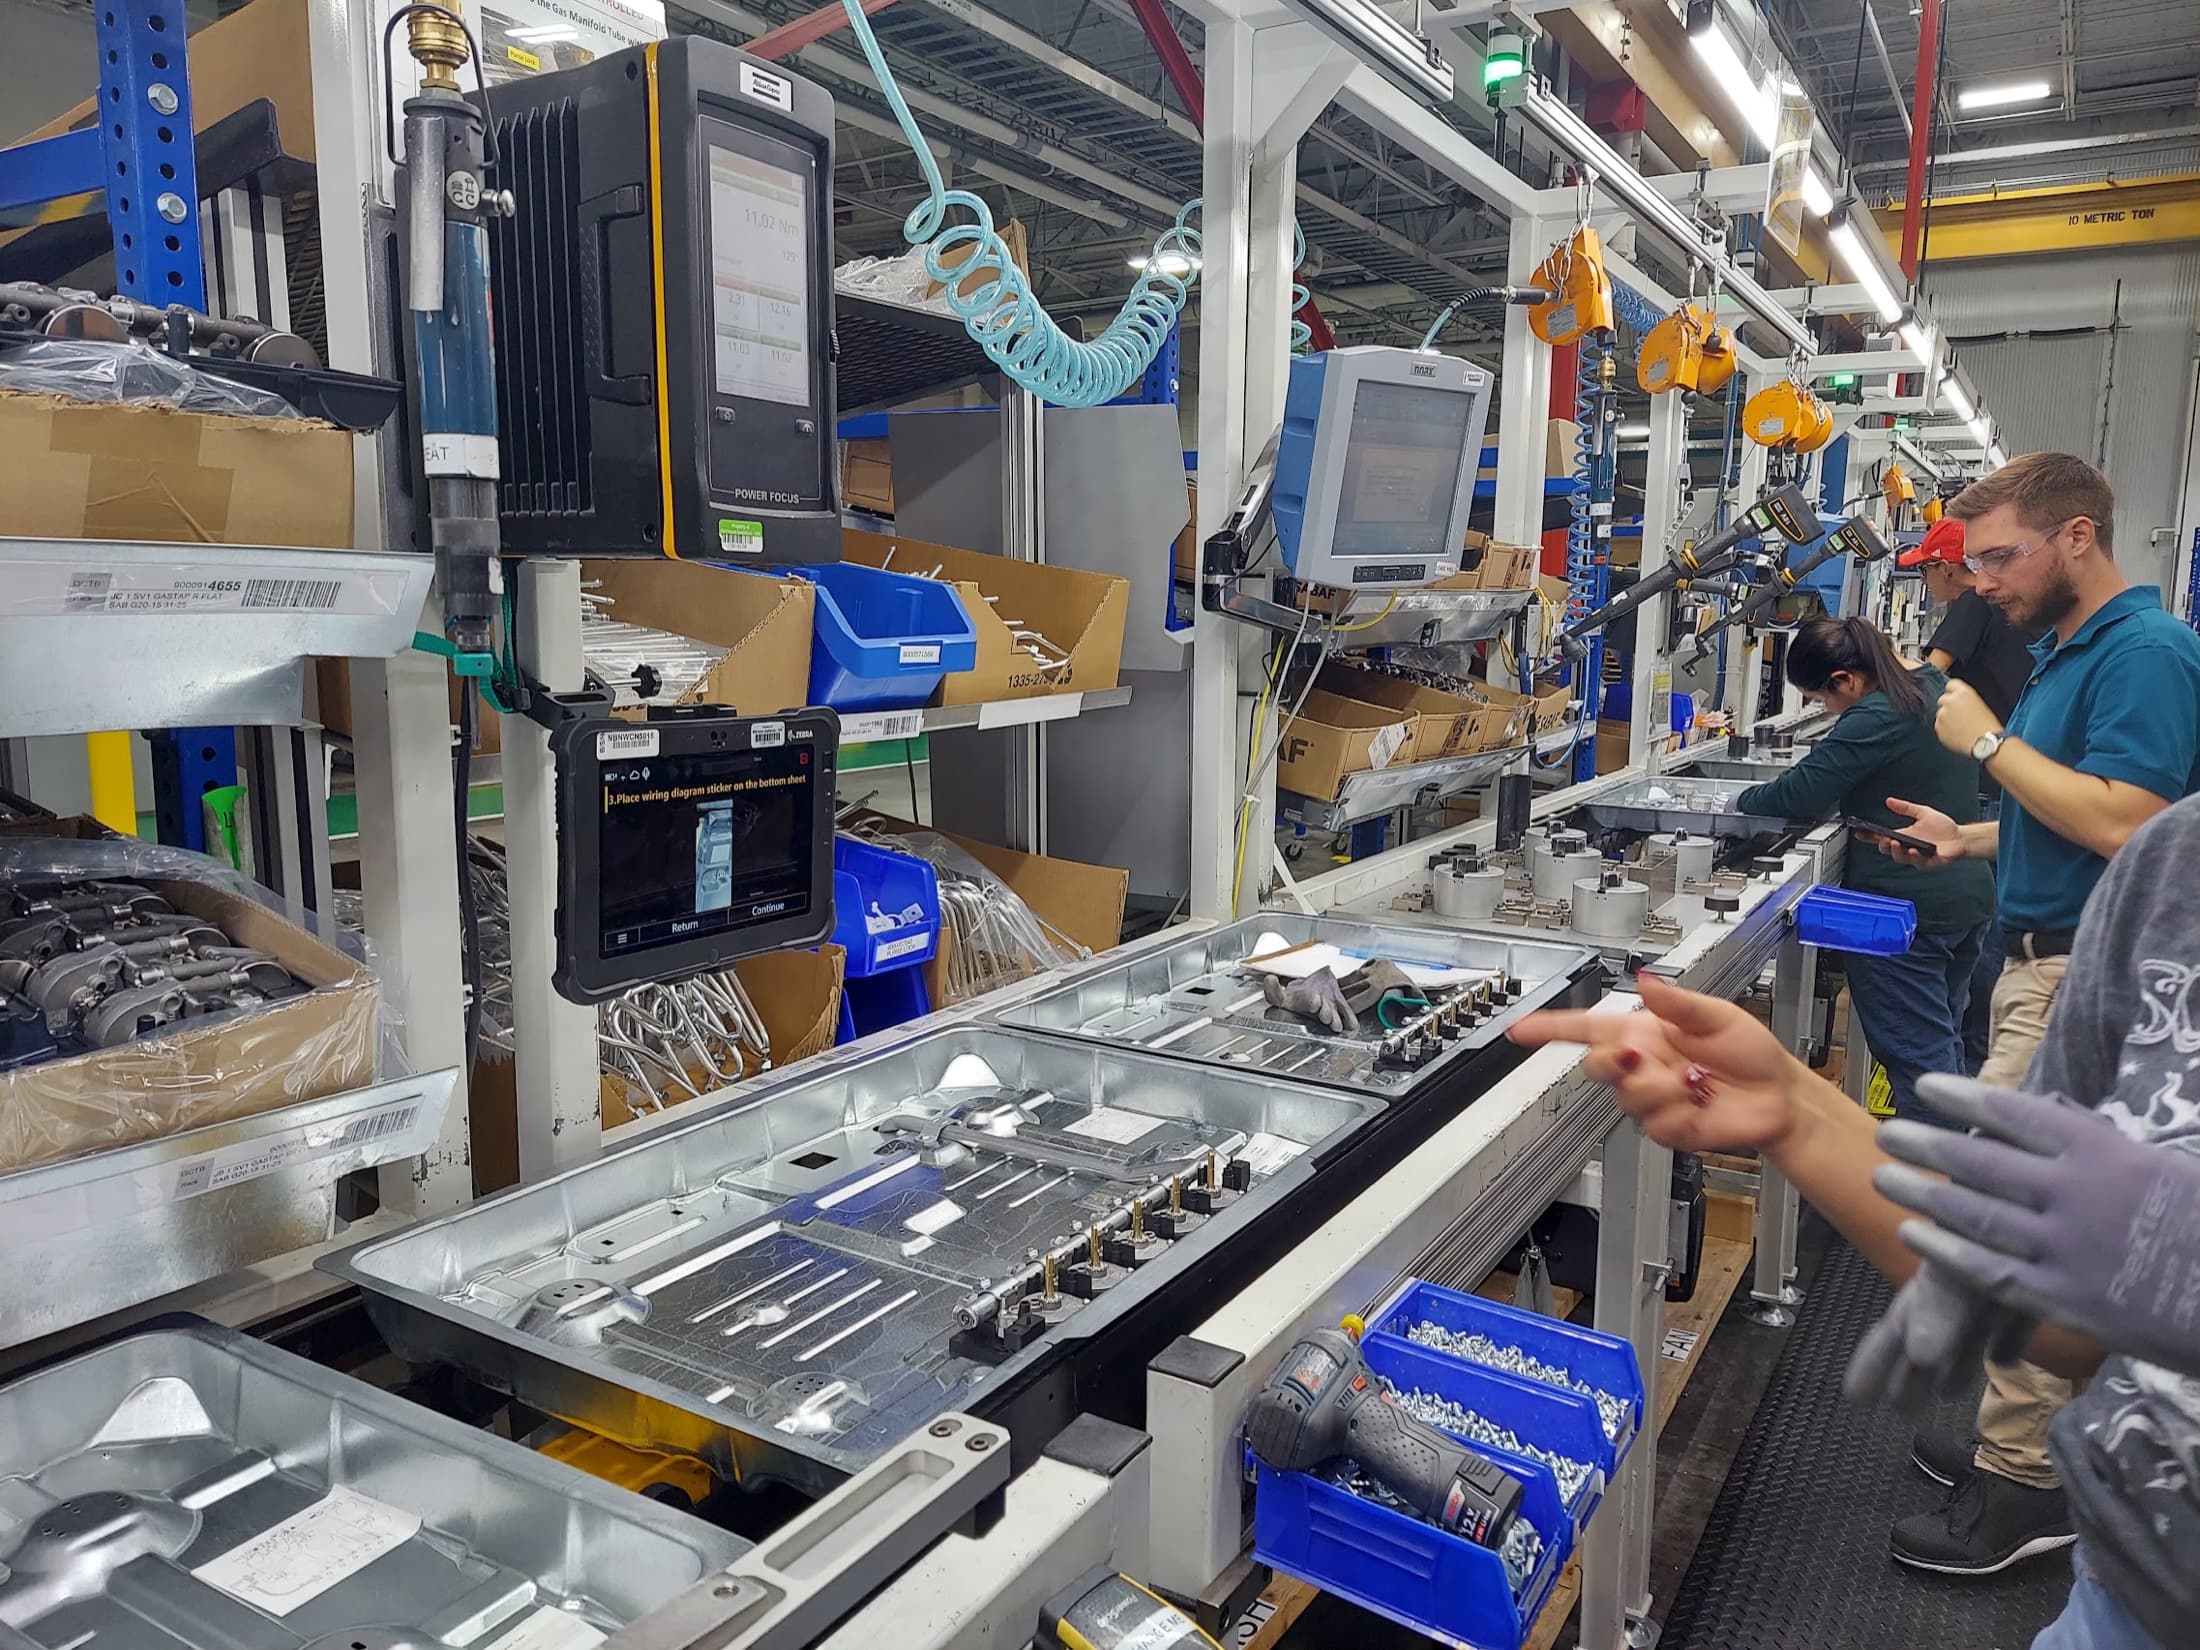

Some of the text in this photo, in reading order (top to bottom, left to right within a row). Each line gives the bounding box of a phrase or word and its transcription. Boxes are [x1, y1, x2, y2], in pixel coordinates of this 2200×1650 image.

[552, 1, 569, 16] Gas
[569, 10, 607, 34] Manifold
[607, 27, 626, 41] Tube
[2083, 211, 2126, 225] METRIC
[2131, 208, 2155, 220] TON
[735, 488, 800, 504] POWER FOCUS
[641, 789, 669, 802] wiring
[671, 785, 705, 800] diagram
[706, 782, 732, 794] sticker
[733, 782, 744, 791] on
[745, 779, 758, 790] the
[759, 776, 786, 788] bottom
[787, 774, 806, 785] sheet
[671, 901, 785, 934] Return Continue
